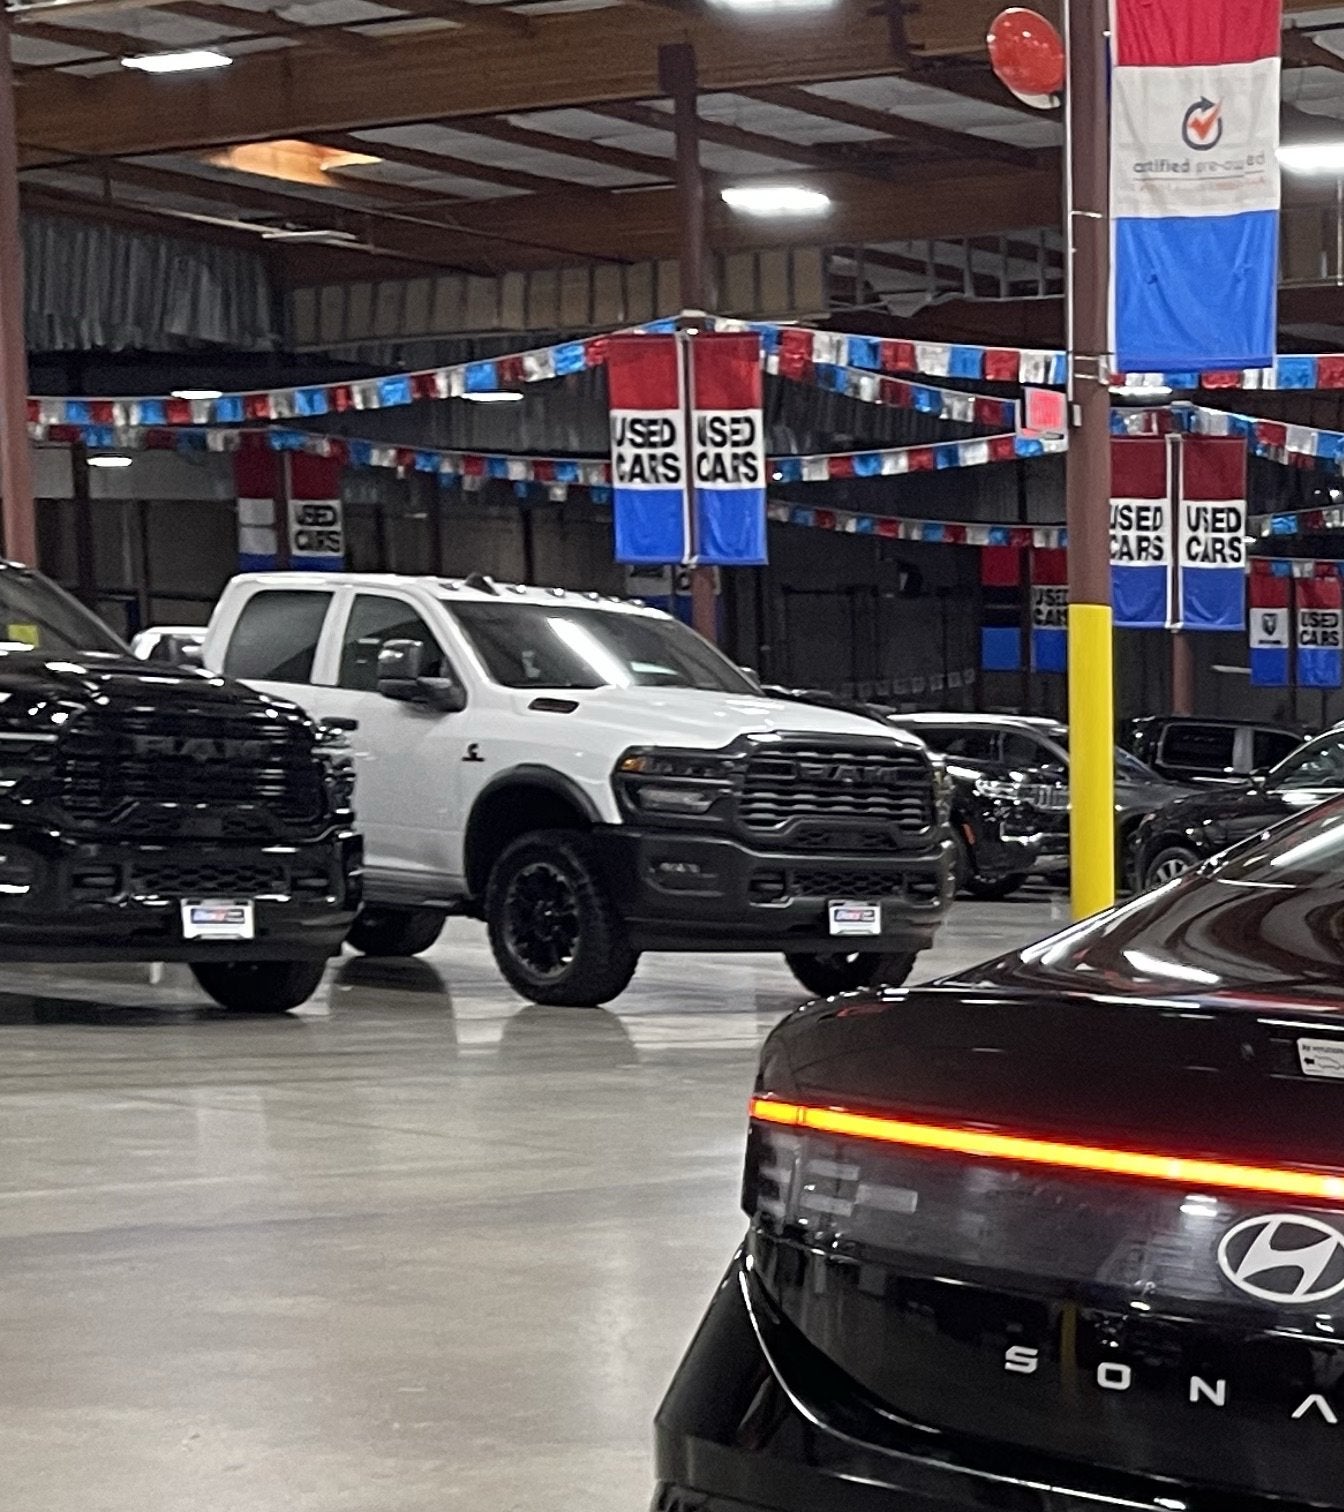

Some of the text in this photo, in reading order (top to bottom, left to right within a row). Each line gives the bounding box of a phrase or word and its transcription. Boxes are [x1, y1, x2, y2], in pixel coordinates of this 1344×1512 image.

[696, 451, 759, 483] CARS
[1186, 505, 1242, 533] USED
[1186, 535, 1242, 563] CARS
